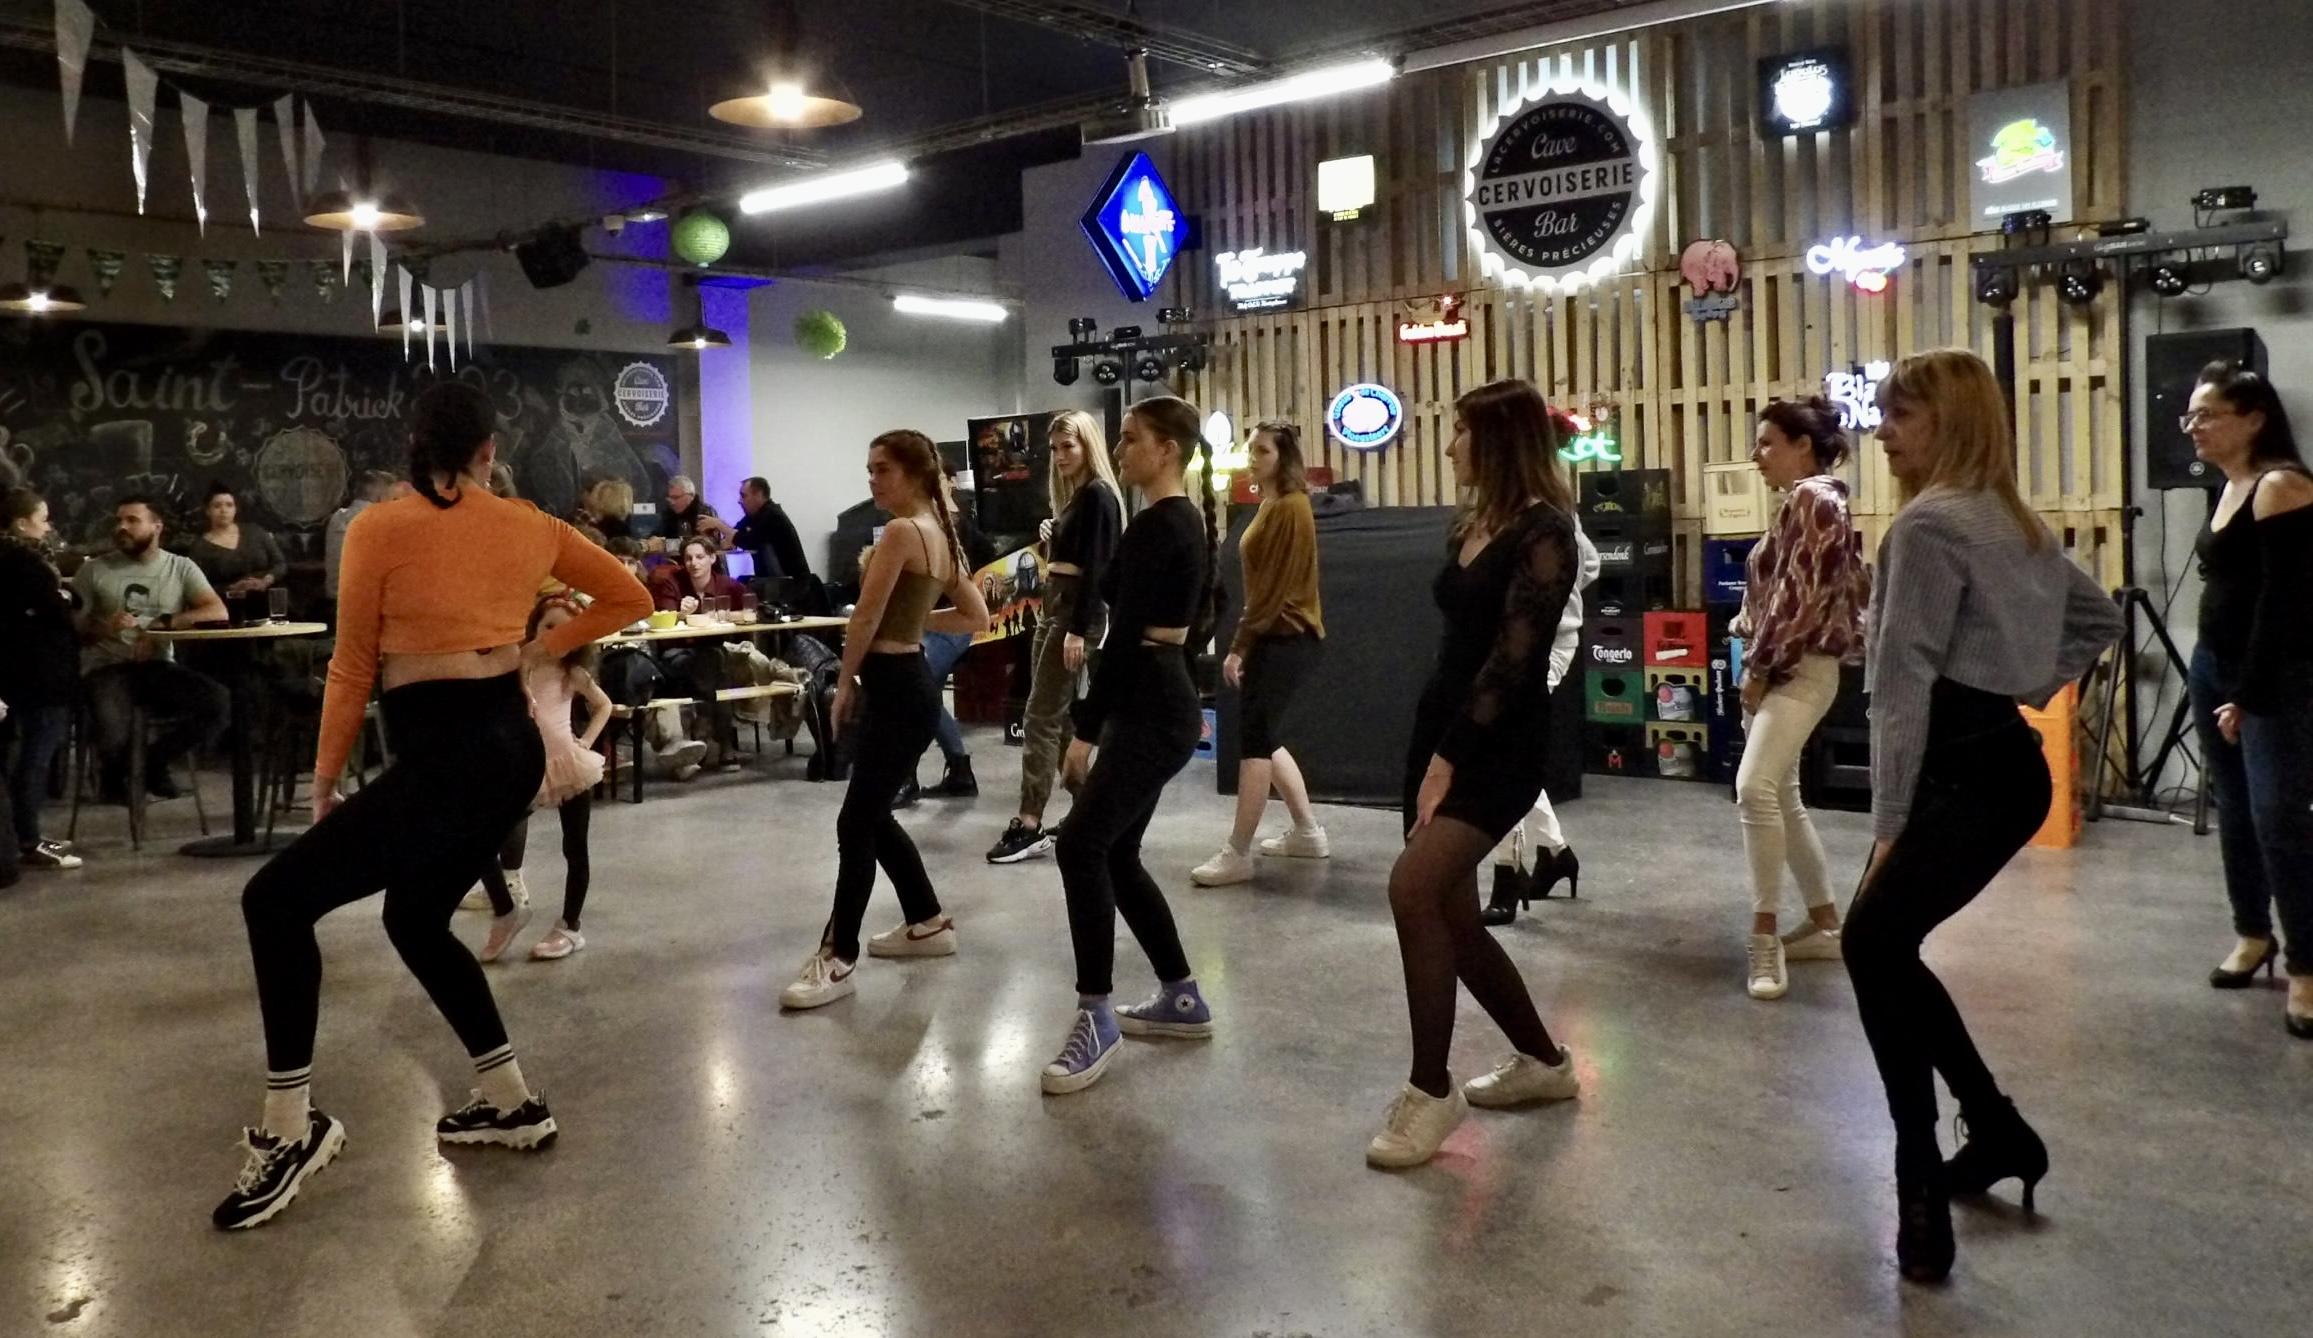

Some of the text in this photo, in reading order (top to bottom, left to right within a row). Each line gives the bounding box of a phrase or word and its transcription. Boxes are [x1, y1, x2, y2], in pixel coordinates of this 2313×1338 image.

[1531, 132, 1577, 160] Cave
[1478, 162, 1633, 206] CERVOISERIE
[1534, 210, 1579, 238] Bar
[617, 389, 664, 399] CERVOISERIE
[1592, 645, 1633, 663] Tongerlo
